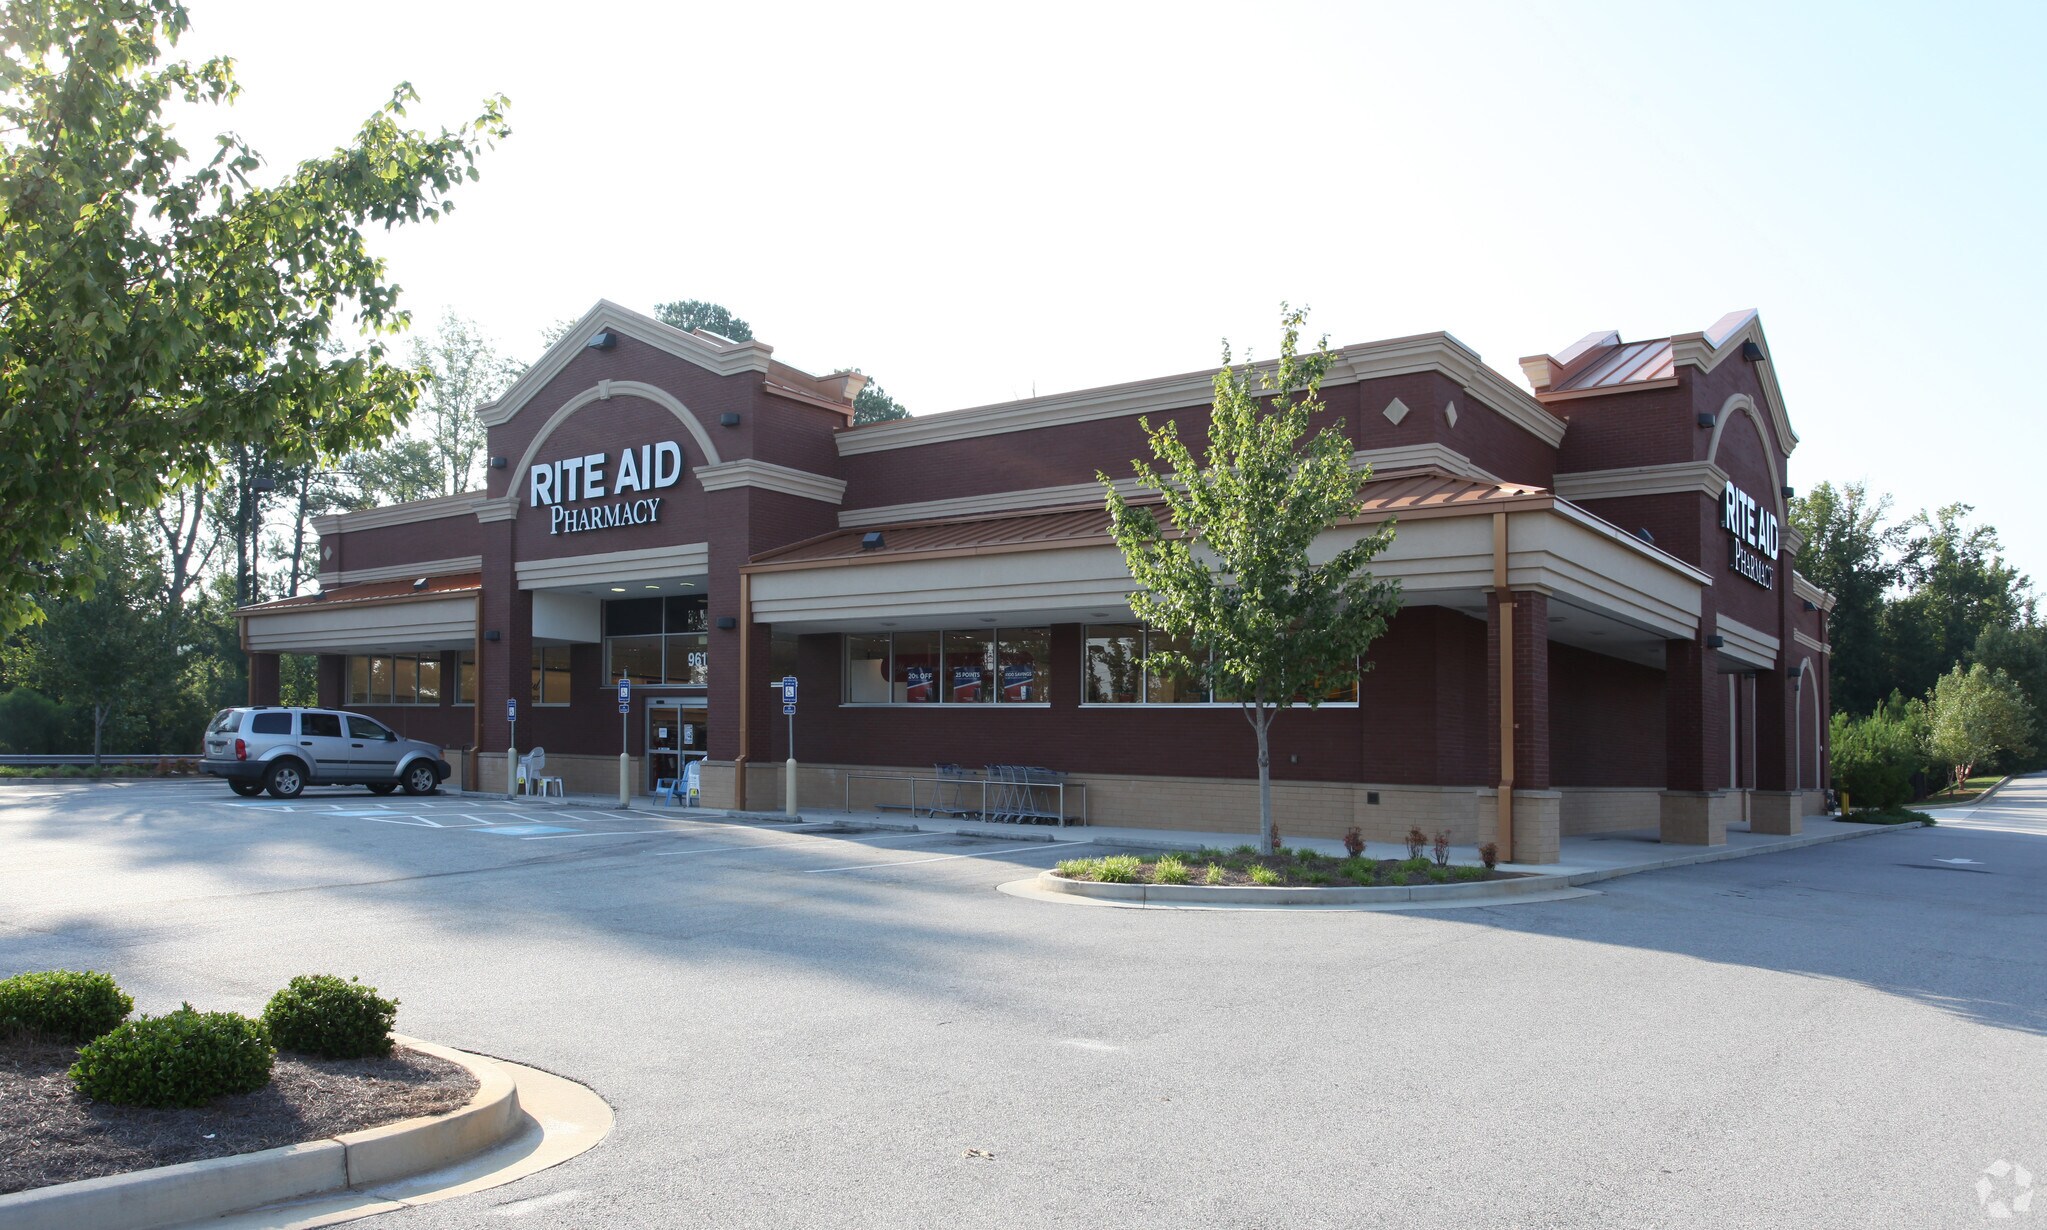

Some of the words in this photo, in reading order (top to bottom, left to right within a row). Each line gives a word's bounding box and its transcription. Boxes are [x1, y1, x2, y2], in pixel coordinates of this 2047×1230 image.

[530, 452, 605, 507] RITE
[613, 440, 682, 495] AID
[550, 497, 660, 535] PHARMACY
[1726, 480, 1756, 547] RITE
[1758, 506, 1779, 561] AID
[1735, 537, 1774, 590] PHARMACY
[688, 652, 708, 667] 961
[919, 672, 933, 680] OFF
